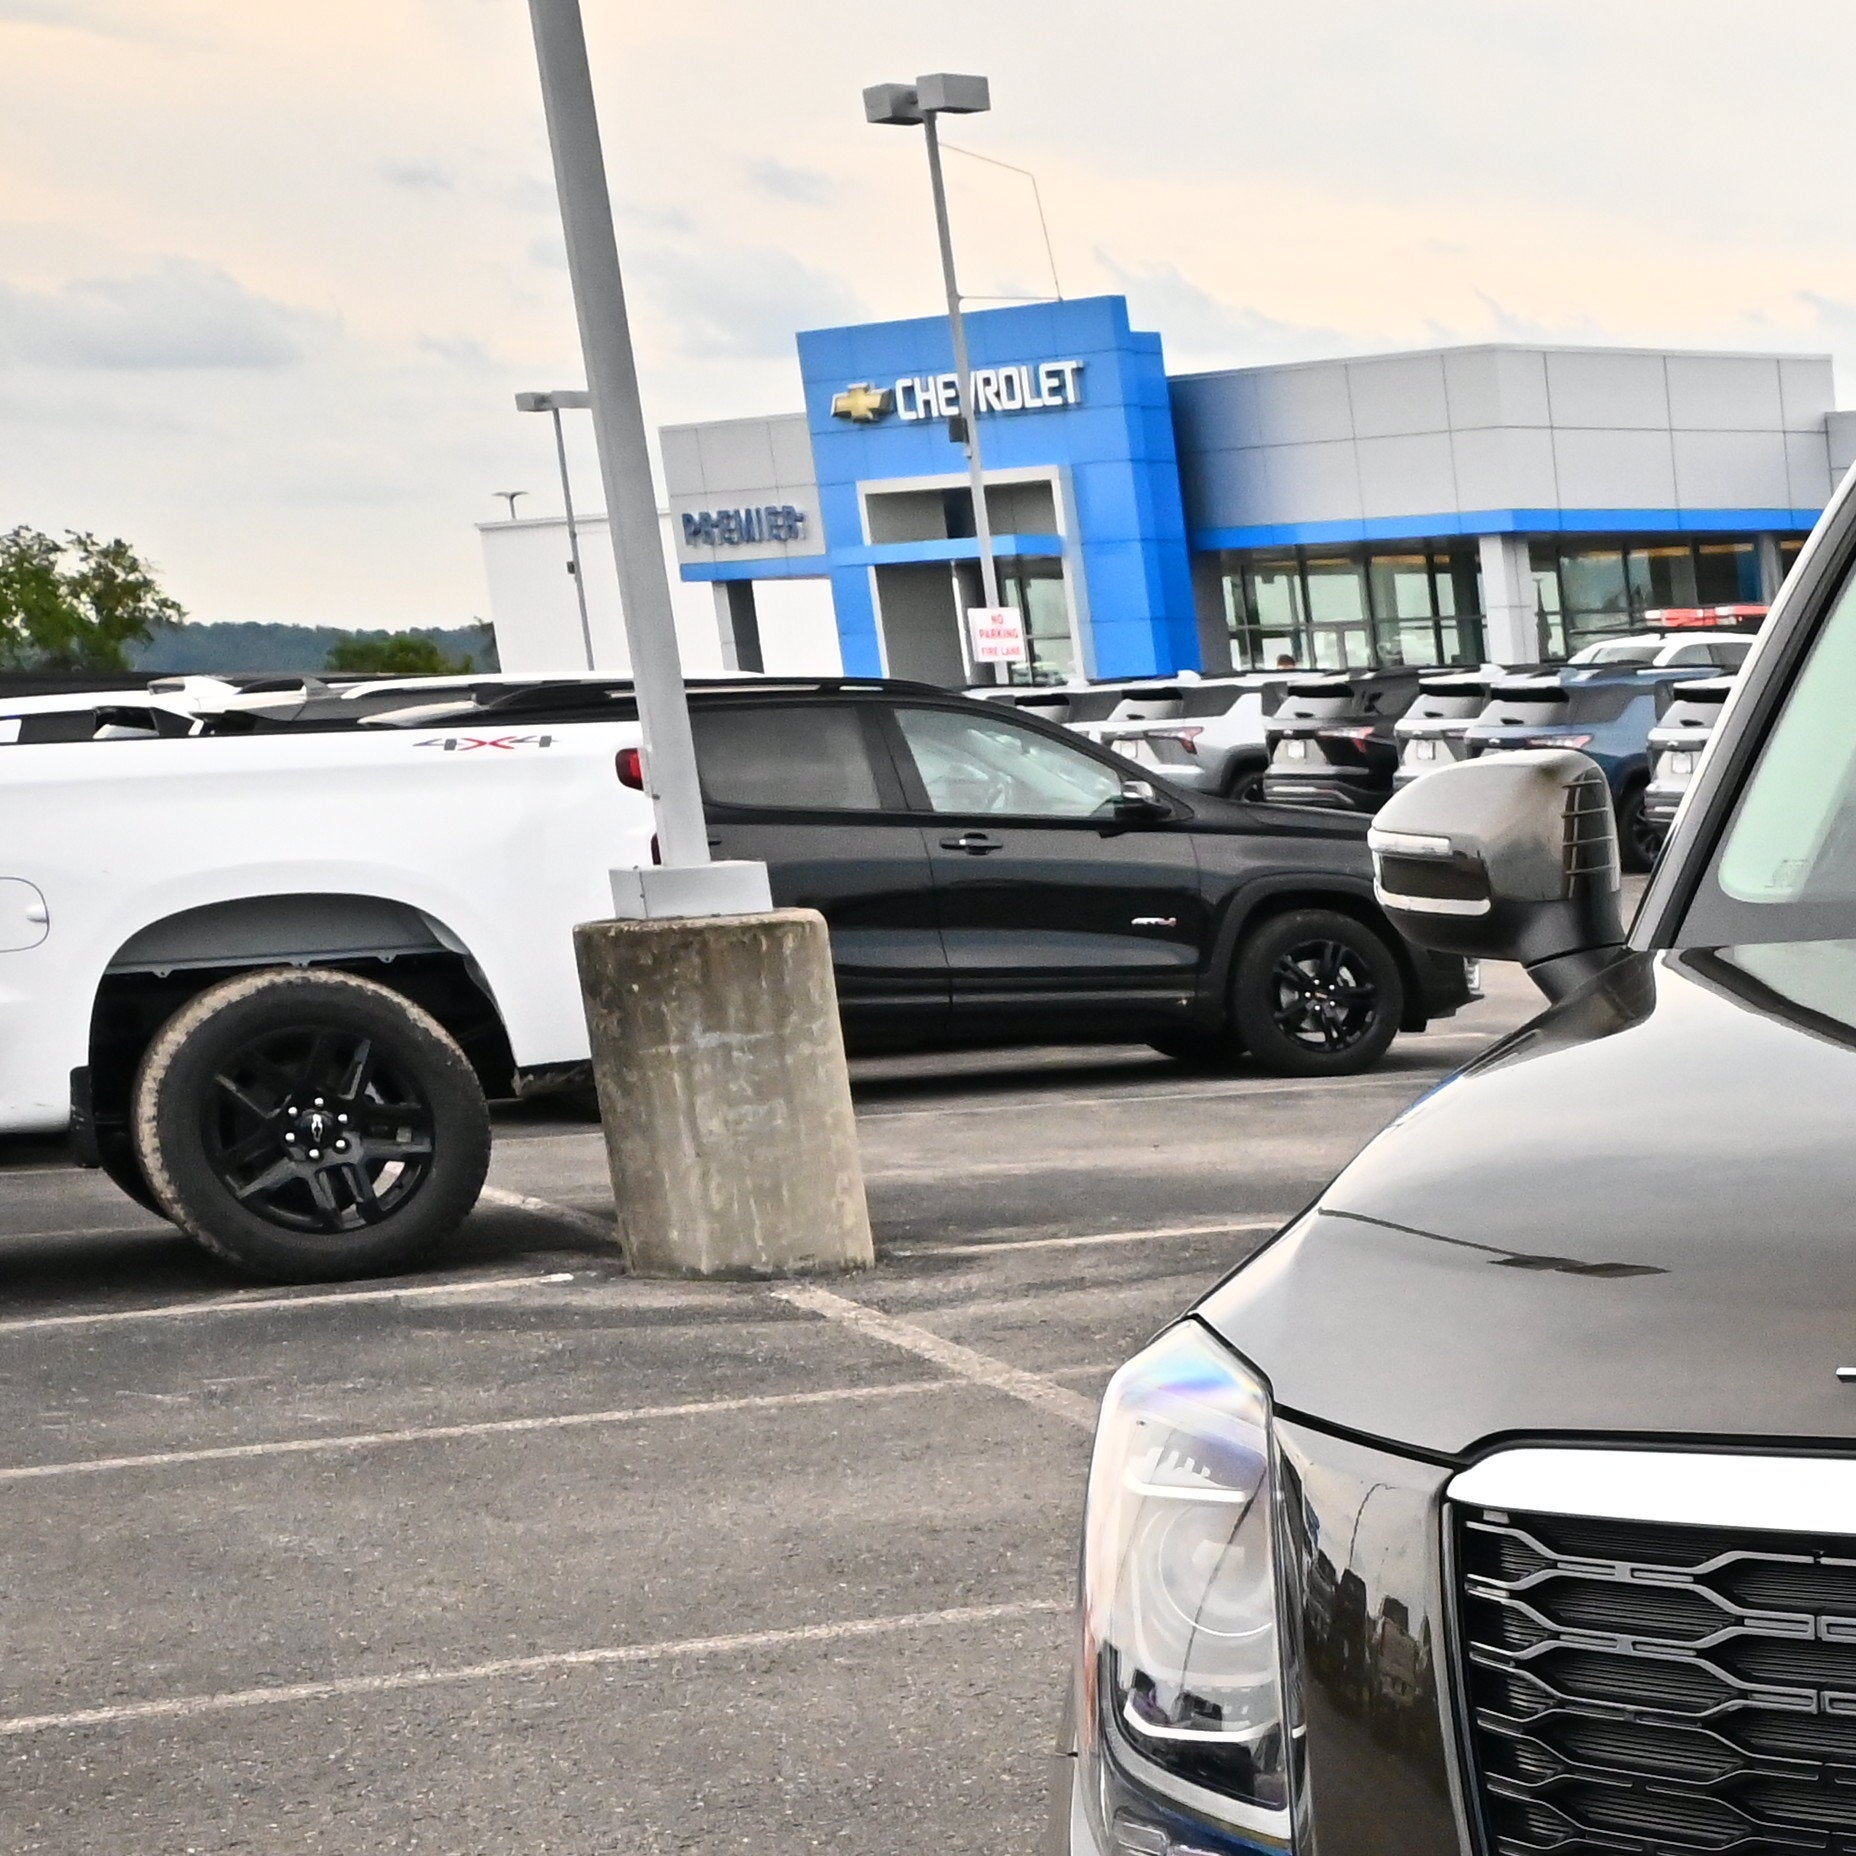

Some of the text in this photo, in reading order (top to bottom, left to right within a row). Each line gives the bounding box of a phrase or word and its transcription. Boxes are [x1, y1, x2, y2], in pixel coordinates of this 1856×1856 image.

[681, 505, 806, 546] PREMIER
[991, 613, 1004, 624] NO
[979, 628, 1019, 639] PARKING
